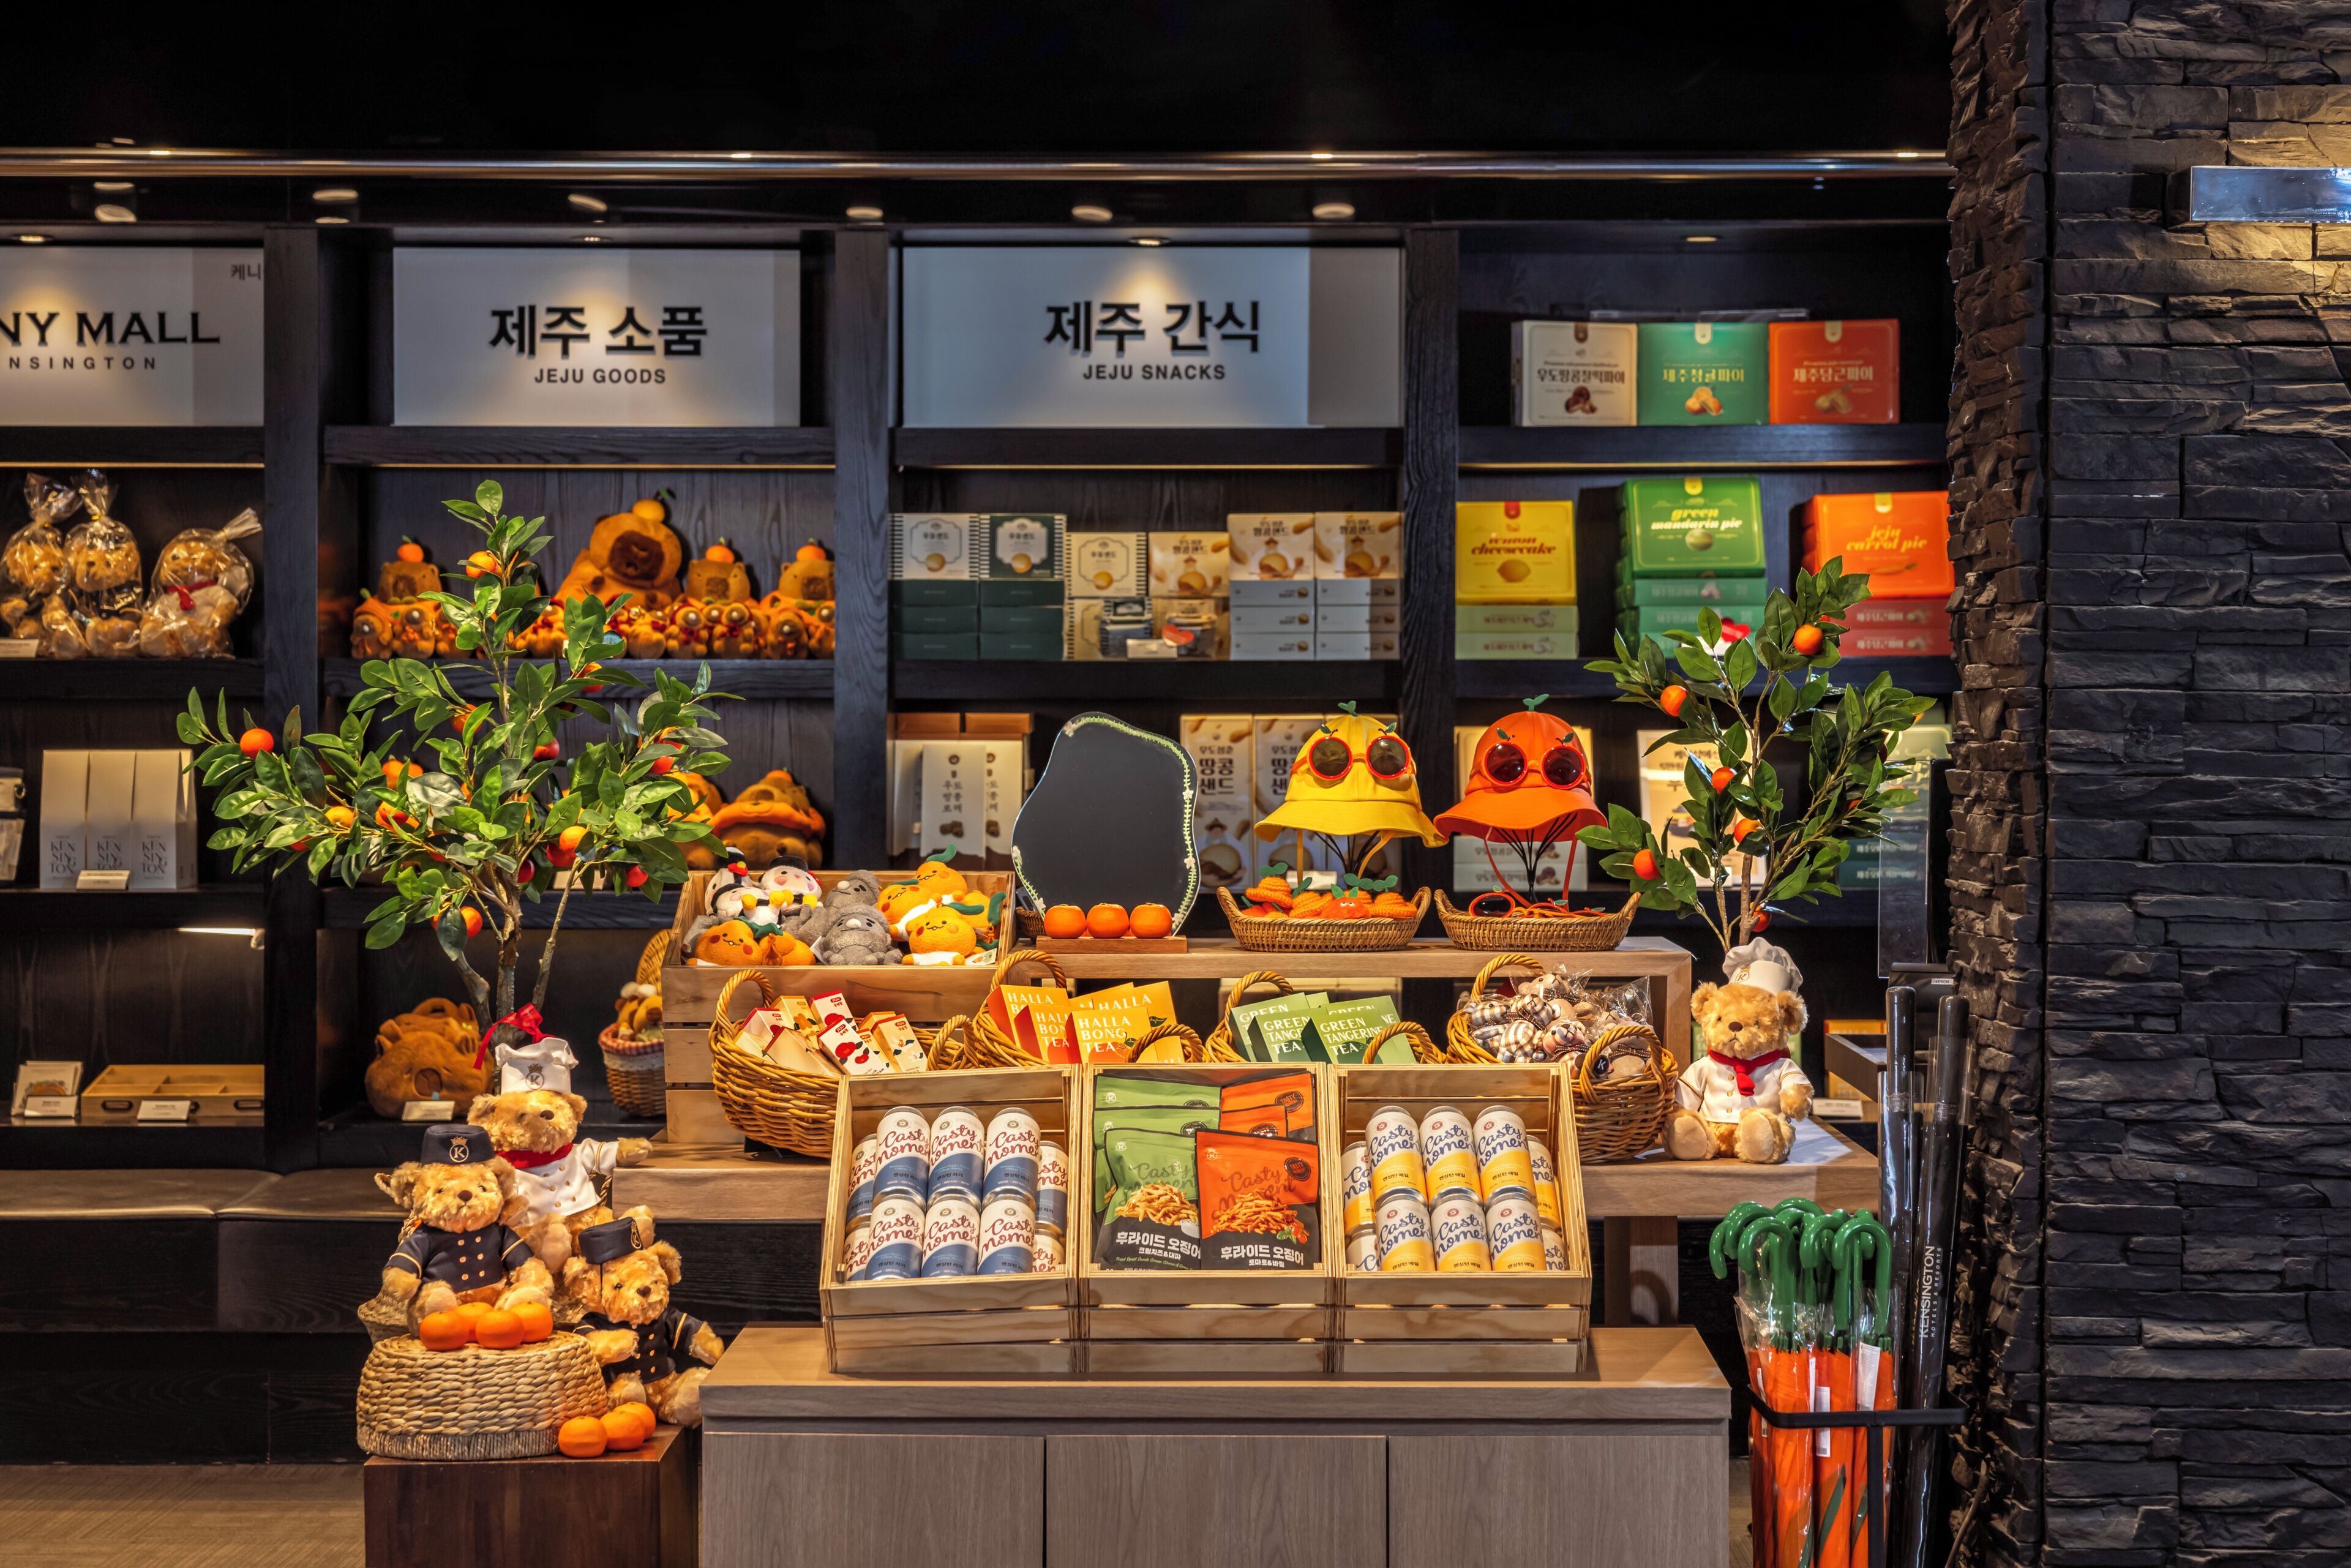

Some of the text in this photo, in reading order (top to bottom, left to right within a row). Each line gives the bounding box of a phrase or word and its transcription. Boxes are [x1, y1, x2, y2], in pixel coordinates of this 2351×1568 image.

[77, 312, 220, 347] MALL
[489, 304, 707, 358] 제주 소품
[1044, 300, 1261, 356] 제주 간식
[534, 368, 666, 384] JEJU GOODS
[1082, 364, 1226, 380] JEJU SNACKS
[1671, 508, 1719, 521] green
[1651, 517, 1743, 531] mandarin pie
[1869, 525, 1902, 541] jeju
[1471, 543, 1556, 556] cheesecake
[1900, 536, 1928, 553] pie
[1199, 758, 1234, 776] 땅콩
[1199, 778, 1235, 795] 샌드
[1007, 992, 1054, 1005] HALLA
[1099, 994, 1152, 1010] HALLA
[1039, 1024, 1066, 1035] BON
[1078, 1016, 1131, 1029] HALLA
[1264, 1016, 1311, 1031] GREEN
[1320, 1018, 1366, 1033] GREEN
[1041, 1037, 1070, 1048] TEA
[1081, 1027, 1127, 1041] BONG
[1324, 1026, 1382, 1044] TANGERINE
[1083, 1041, 1116, 1053] TEA
[1271, 1041, 1302, 1054] TEA
[1330, 1041, 1359, 1056] TEA
[1597, 1060, 1607, 1070] K
[879, 1129, 929, 1149] Casty
[931, 1124, 977, 1154] Casty
[989, 1130, 1040, 1149] Casty
[1368, 1125, 1415, 1157] Casty
[1423, 1124, 1469, 1155] Casty
[1477, 1123, 1522, 1155] Casty
[1221, 1166, 1282, 1192] Casty
[869, 1214, 921, 1240] Casty
[925, 1215, 976, 1240] Casty
[985, 1219, 1035, 1236] Casty
[1378, 1212, 1426, 1244] Casty
[1435, 1214, 1485, 1241] Casty
[1490, 1213, 1539, 1242] Casty
[1116, 1231, 1166, 1248] 후라이드
[1221, 1245, 1304, 1266] 후라이드 오징어
[1919, 1246, 1935, 1338] KENSINGTON
